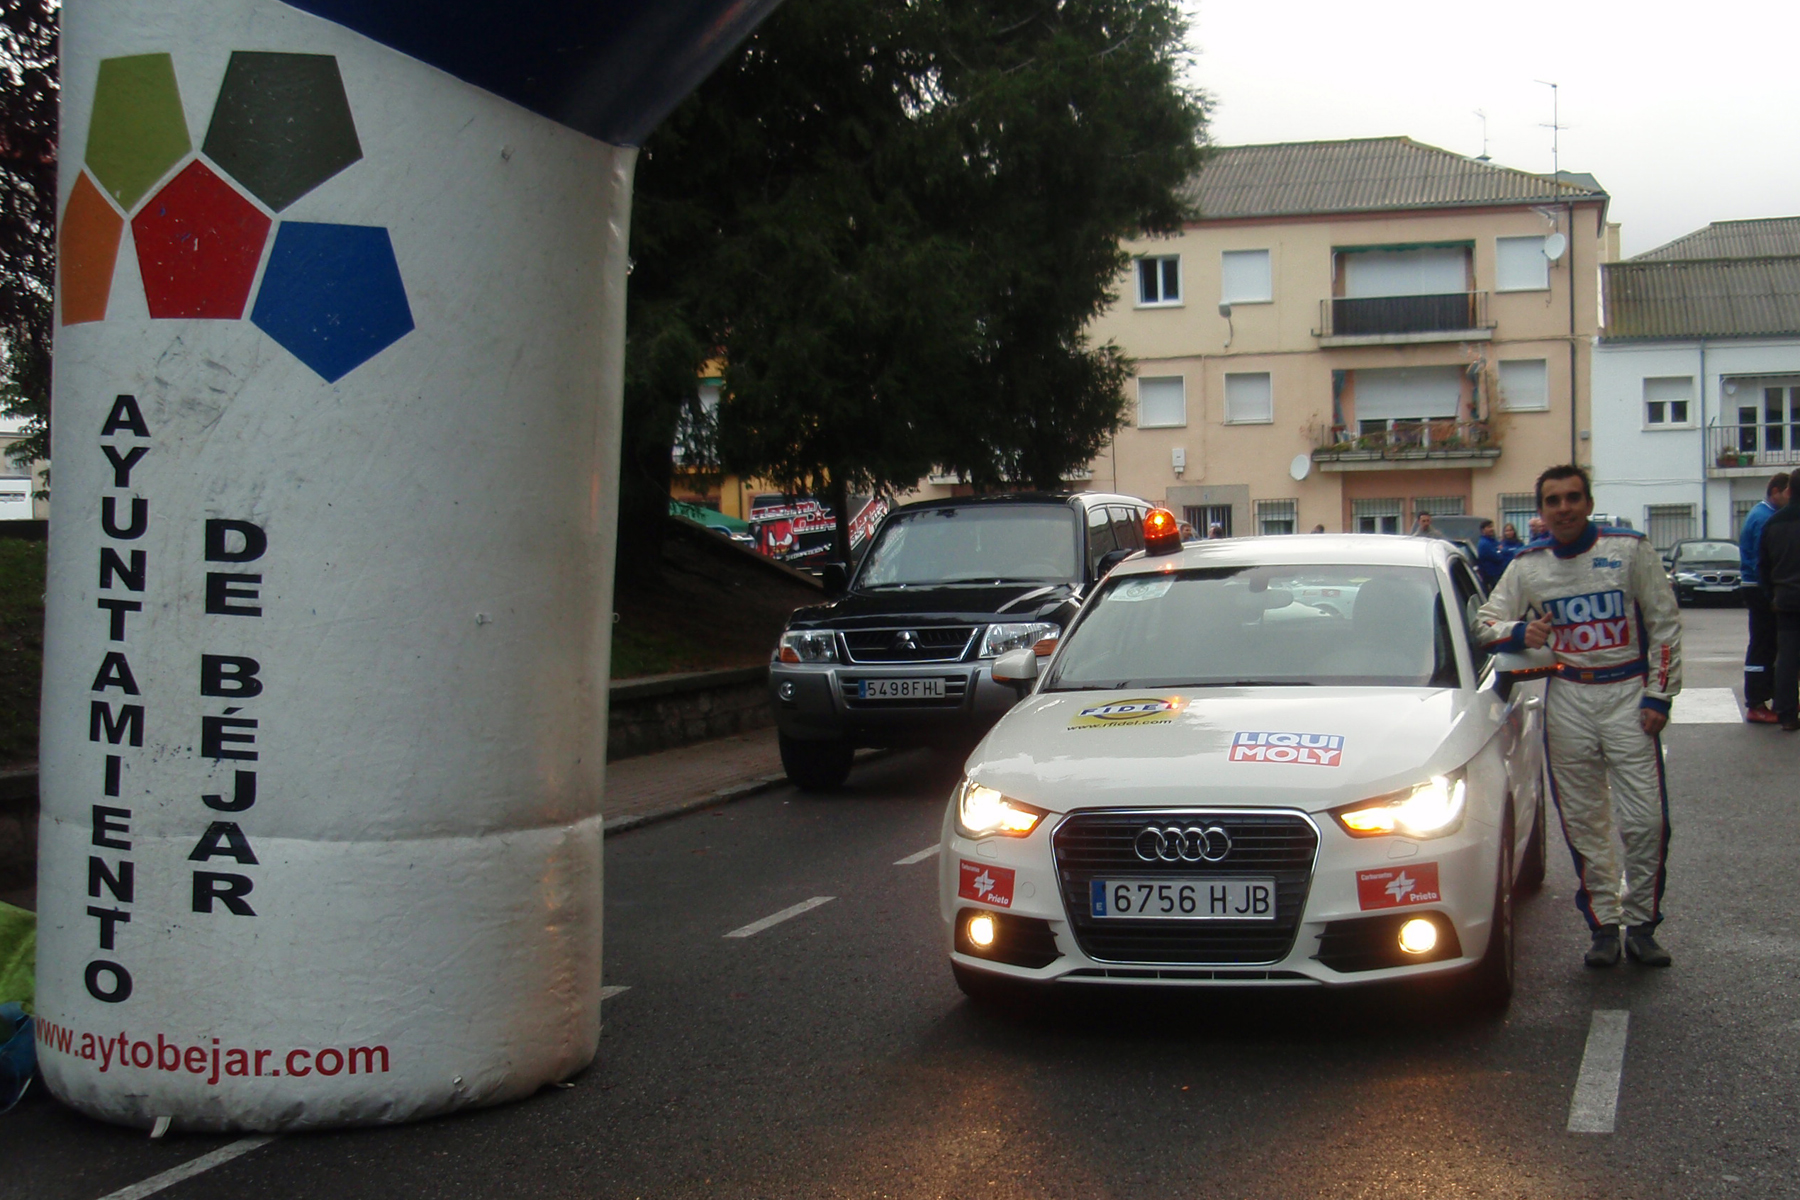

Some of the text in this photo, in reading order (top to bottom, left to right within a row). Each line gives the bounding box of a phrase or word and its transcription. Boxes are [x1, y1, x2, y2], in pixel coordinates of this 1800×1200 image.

[1556, 619, 1626, 652] MOLY
[84, 394, 151, 1003] AYUNTAMIENTO
[188, 518, 268, 917] DE BÉJAR
[1067, 719, 1172, 732] www.rfidel.com
[1238, 732, 1340, 749] LIQUI
[1234, 746, 1341, 765] MOLY
[987, 893, 1010, 906] Prieto
[1114, 884, 1197, 914] 6756
[1409, 891, 1438, 903] Prieto
[36, 1016, 390, 1085] www.aytobejar.com
